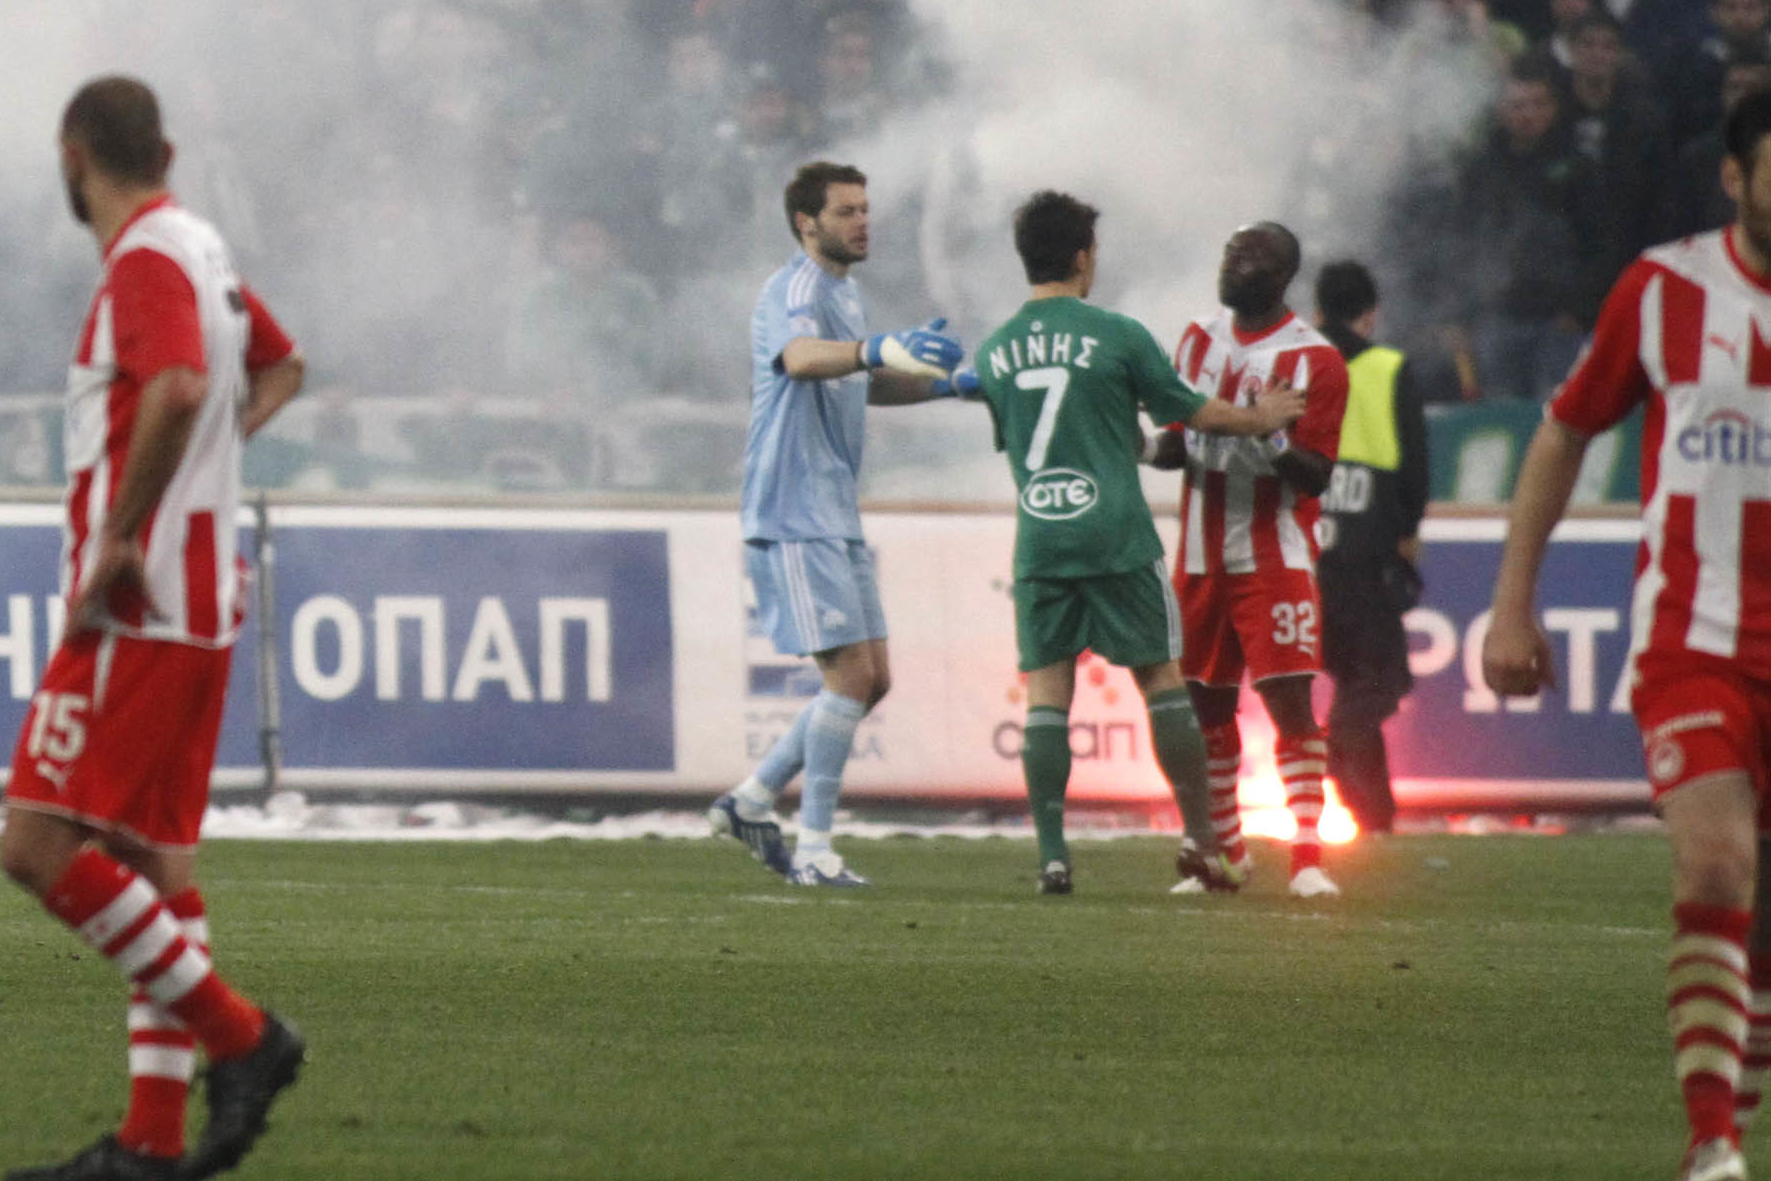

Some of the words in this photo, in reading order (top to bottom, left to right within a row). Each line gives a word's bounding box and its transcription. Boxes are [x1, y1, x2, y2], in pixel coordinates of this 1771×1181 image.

[989, 331, 1099, 379] ΝΙΝΗΣ
[1014, 366, 1070, 471] 7
[291, 595, 611, 702] ΟΠΑΠ
[1271, 600, 1318, 645] 32
[28, 689, 88, 762] 15
